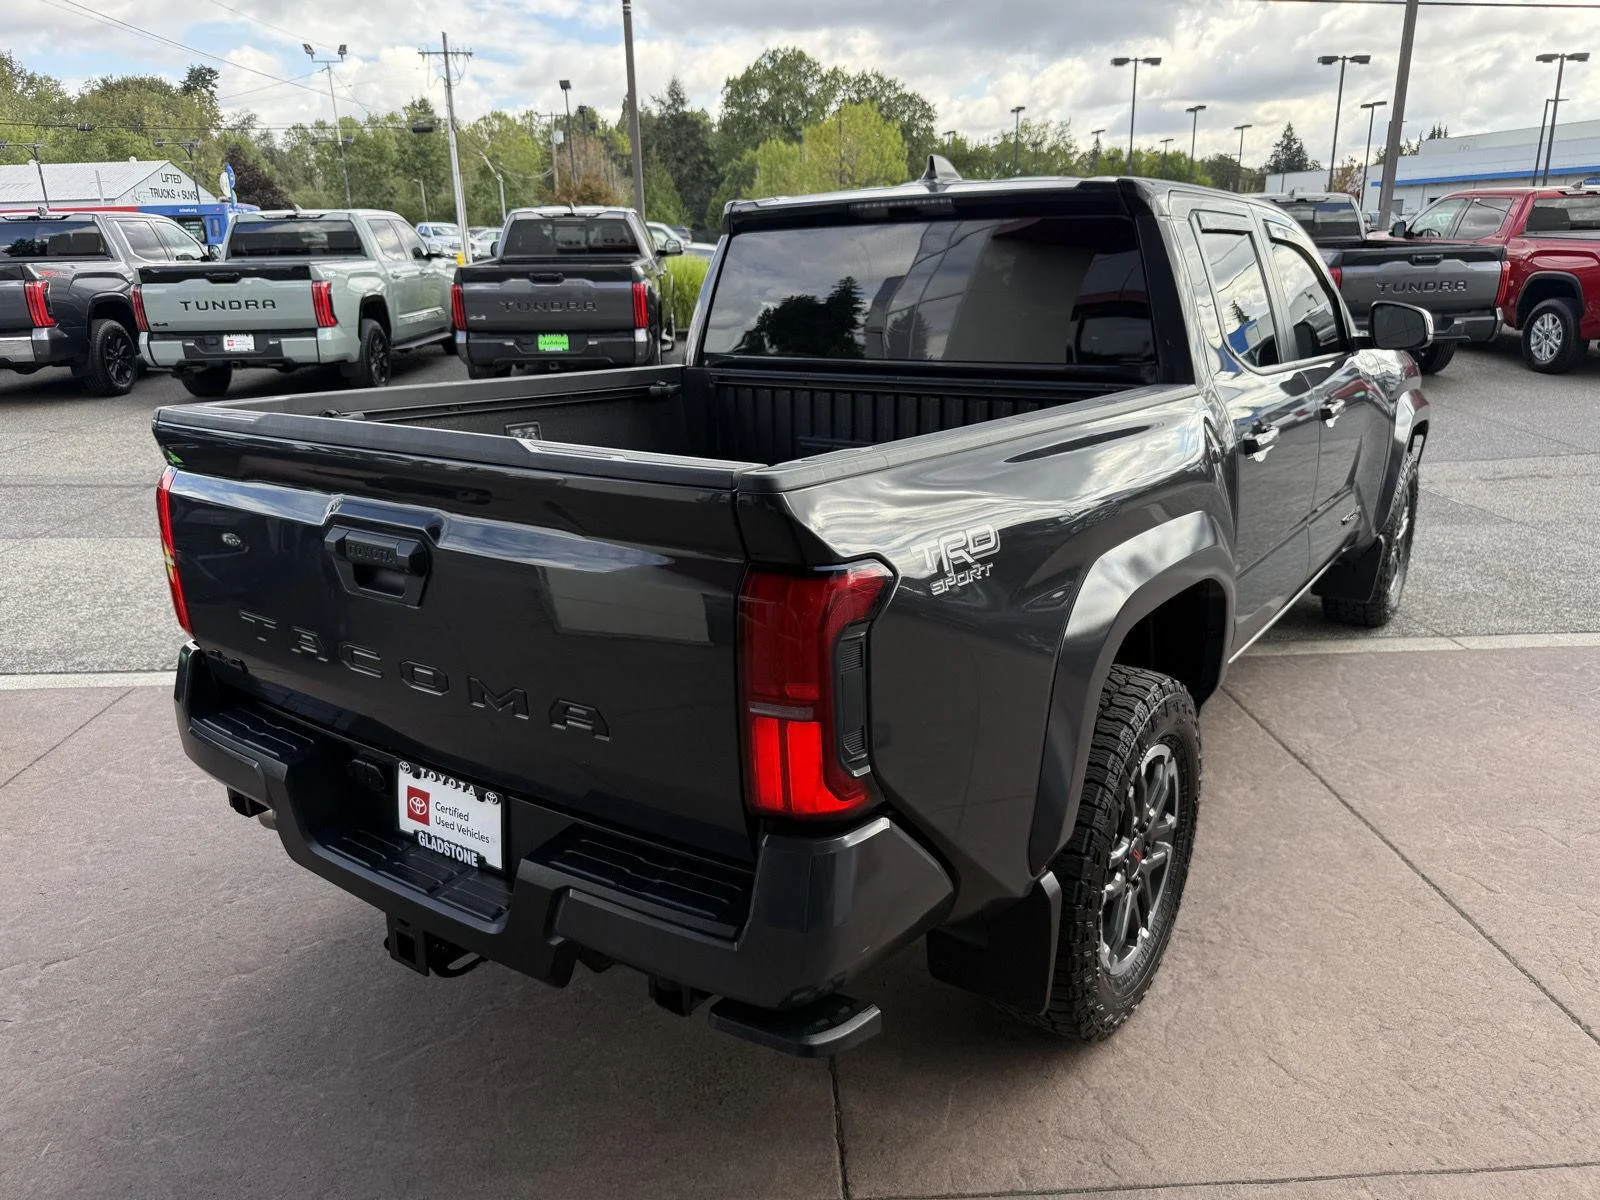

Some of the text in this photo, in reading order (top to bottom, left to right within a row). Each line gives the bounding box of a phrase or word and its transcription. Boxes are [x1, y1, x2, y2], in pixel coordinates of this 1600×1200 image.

[160, 172, 182, 184] LIFTED
[149, 187, 175, 199] TRUCKS
[1376, 279, 1468, 295] TUNDRA
[180, 300, 276, 312] TUNDRA
[499, 300, 597, 313] TUNDRA
[909, 523, 1001, 576] TRD
[930, 561, 994, 596] SPORT
[240, 610, 610, 741] TACOMA
[419, 767, 476, 796] TOYOTA
[435, 801, 470, 822] Certified
[435, 815, 490, 844] Used Vehicles
[418, 831, 479, 868] GLADSTONE
